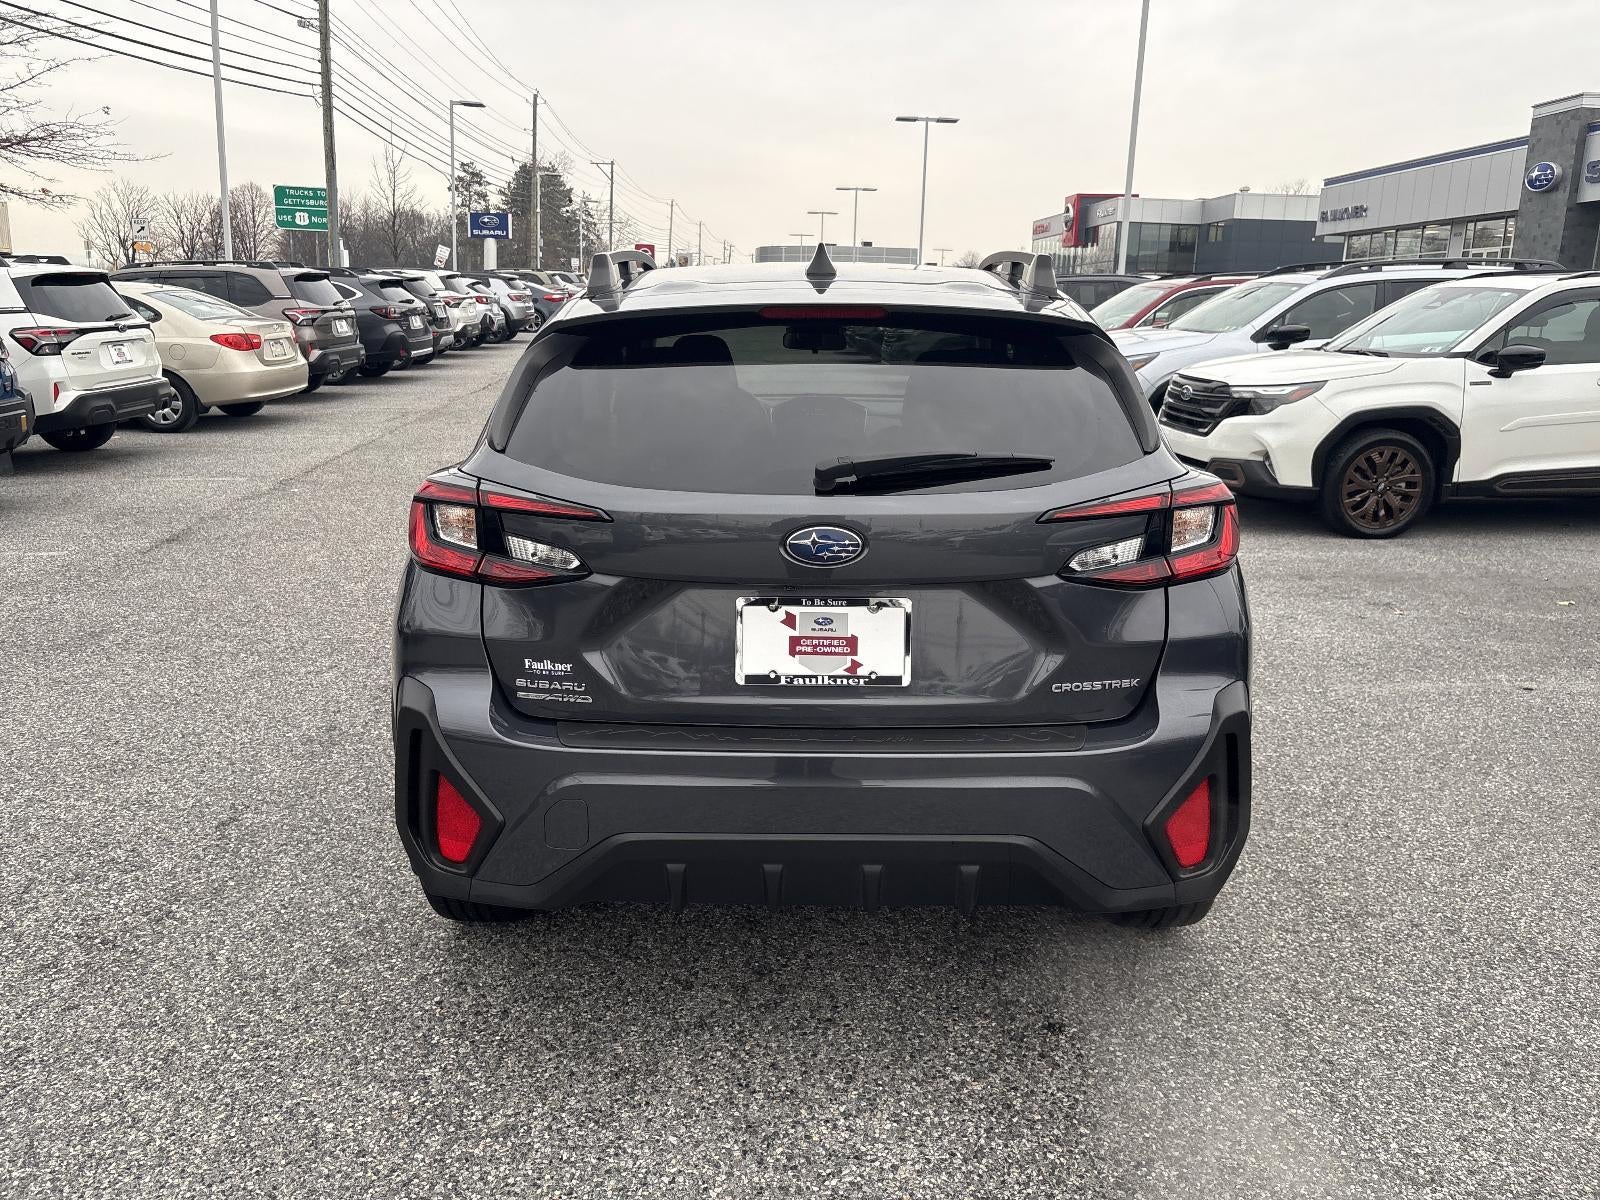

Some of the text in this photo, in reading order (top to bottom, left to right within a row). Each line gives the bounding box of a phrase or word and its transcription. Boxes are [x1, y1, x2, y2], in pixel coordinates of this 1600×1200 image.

[285, 189, 313, 197] TRUCKS
[299, 214, 306, 223] 11
[311, 215, 328, 224] NOR
[801, 598, 847, 606] To Be Sure
[524, 658, 573, 672] Faulkner
[515, 678, 586, 692] SUBARU
[780, 675, 869, 686] Faulkner
[1051, 678, 1141, 693] CROSSTREK
